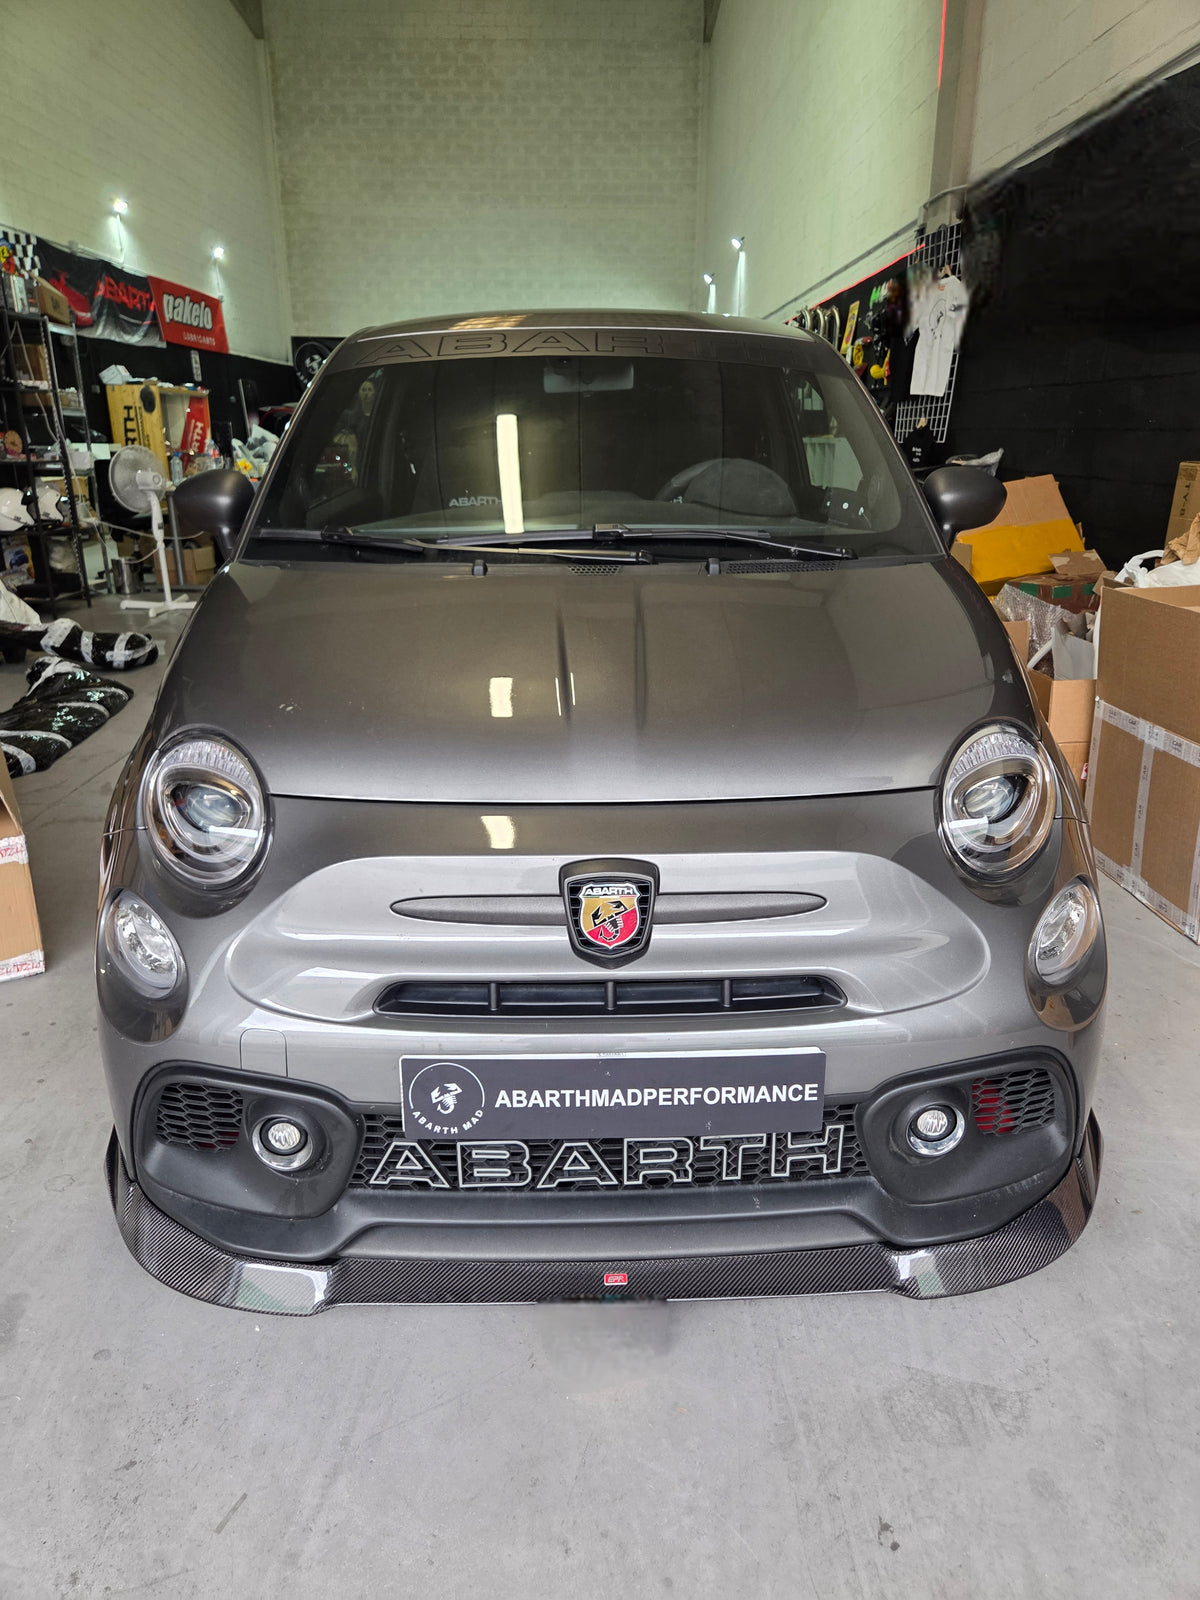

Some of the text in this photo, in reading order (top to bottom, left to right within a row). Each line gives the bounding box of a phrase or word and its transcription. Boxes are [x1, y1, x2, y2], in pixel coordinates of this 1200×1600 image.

[94, 276, 155, 312] ABART
[162, 292, 213, 331] pakelo
[584, 886, 634, 896] ABARTH
[494, 1083, 819, 1108] ABARTHMADPERFORMANCE
[412, 1108, 484, 1135] ABARTH MAD
[369, 1124, 845, 1188] ABARTH
